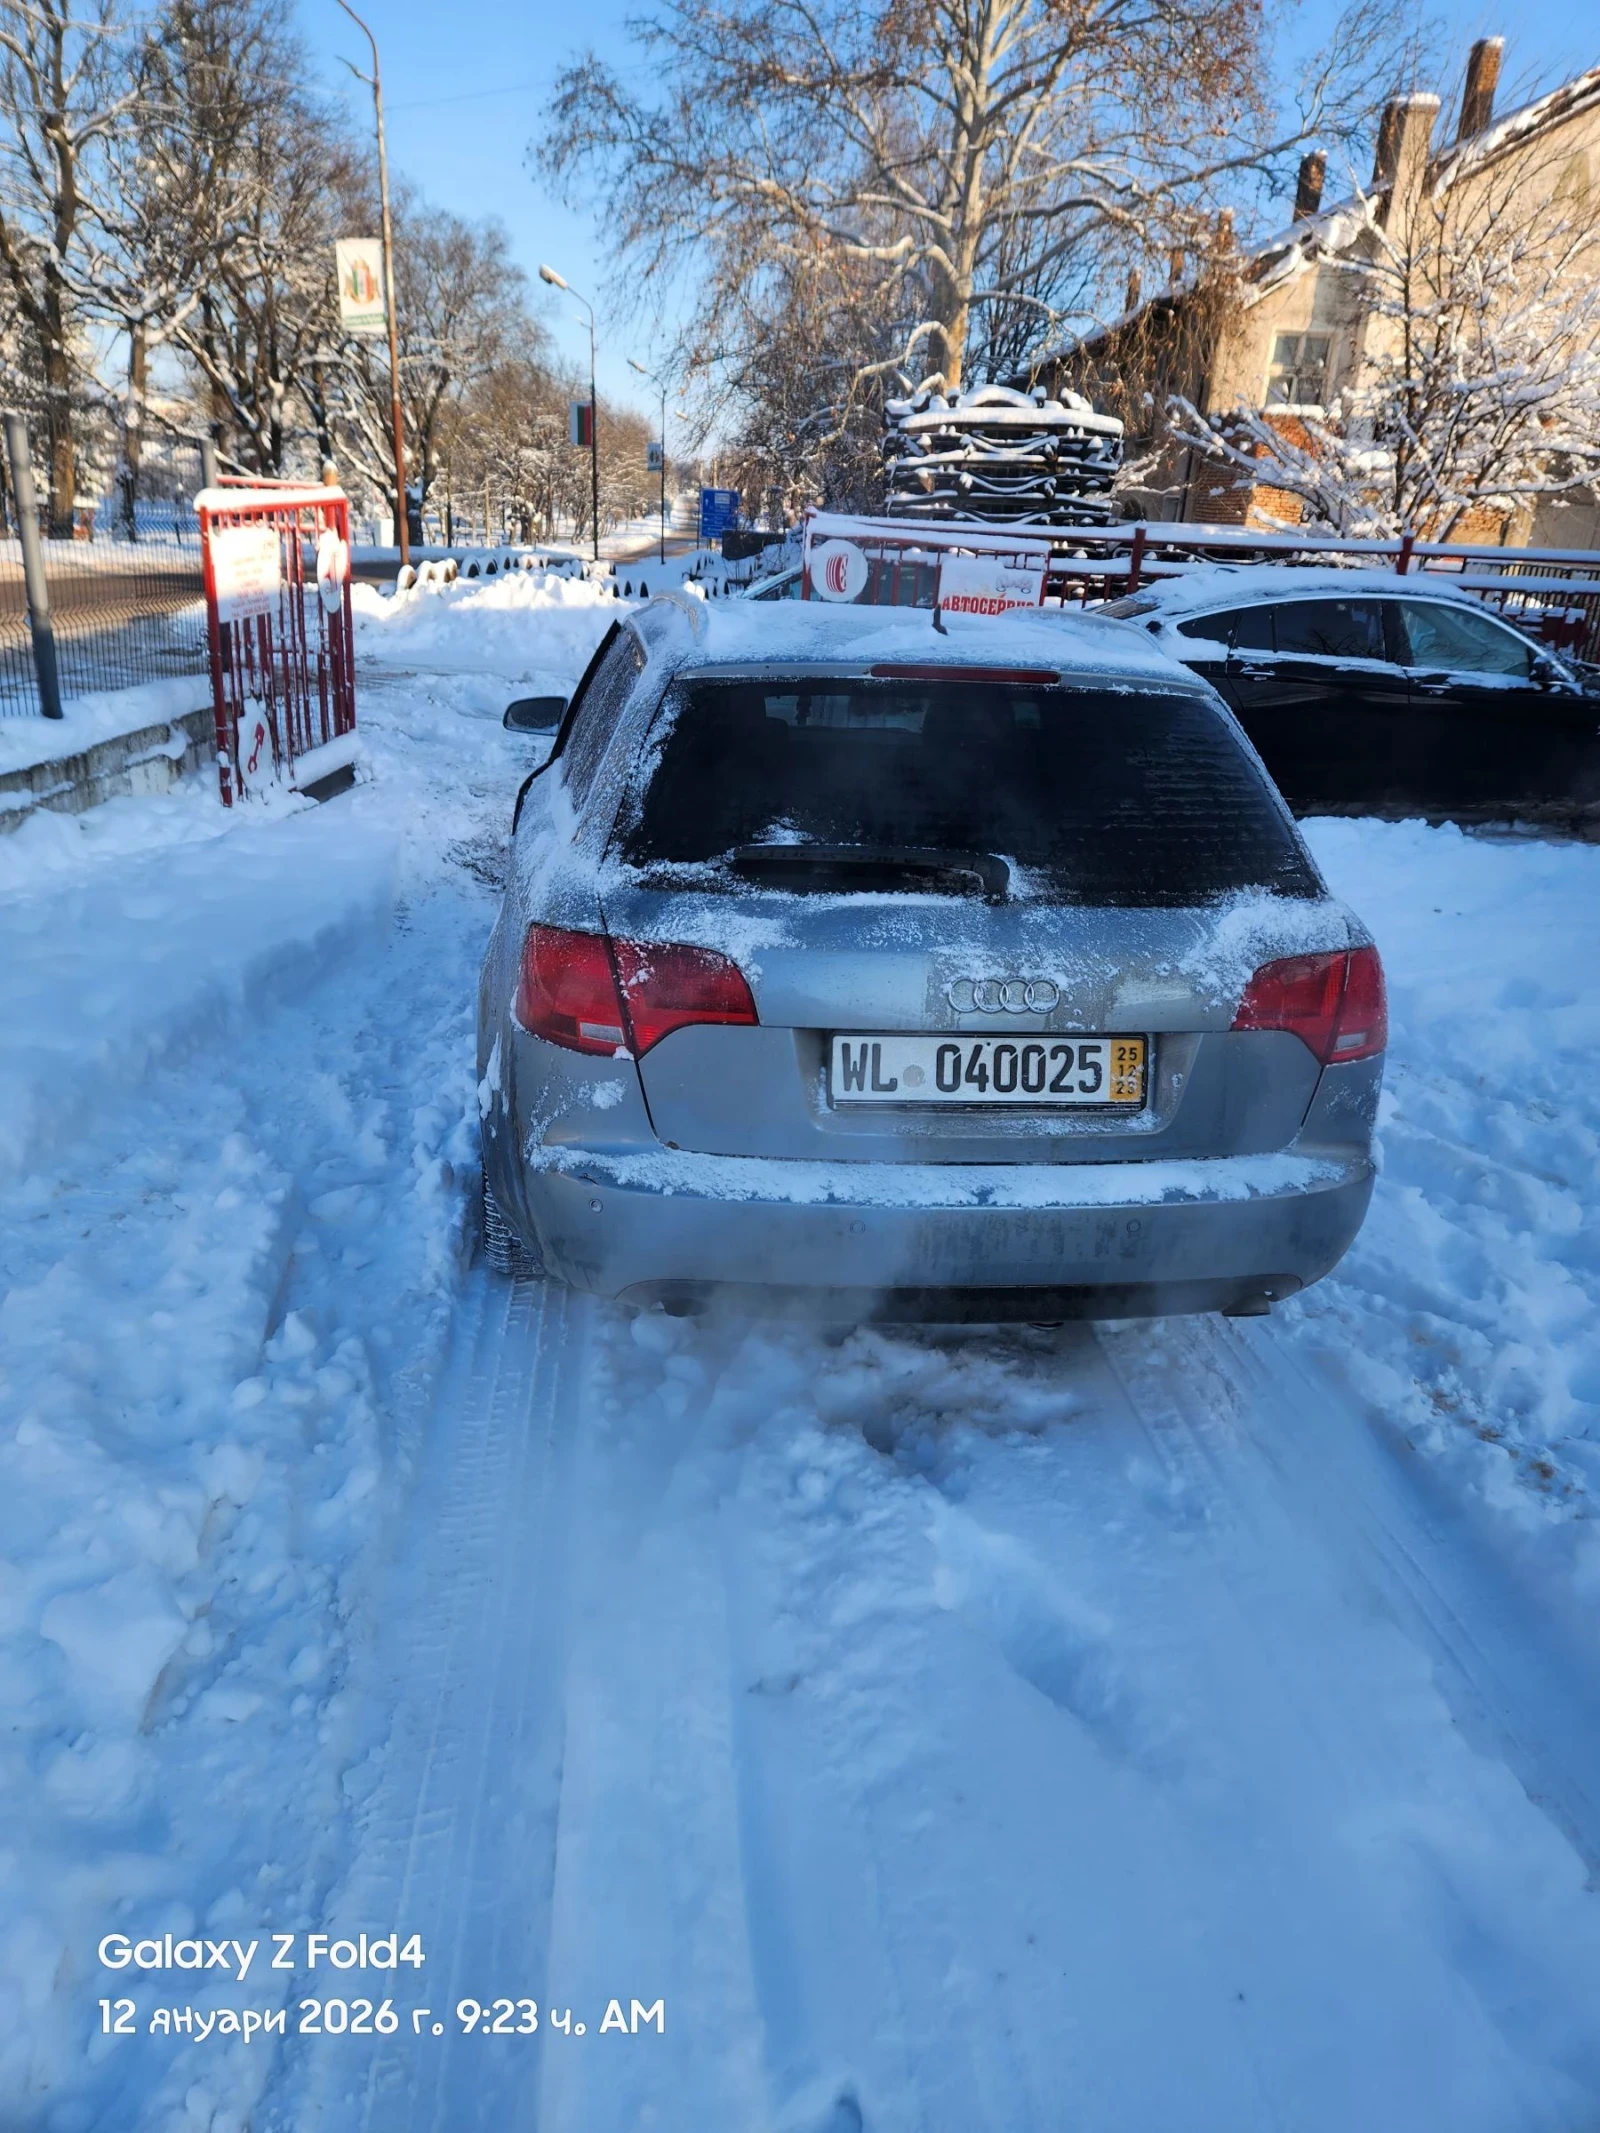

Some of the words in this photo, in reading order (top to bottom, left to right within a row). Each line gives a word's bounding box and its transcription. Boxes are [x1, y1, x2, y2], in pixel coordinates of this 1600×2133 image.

[1117, 1046, 1138, 1061] 25
[841, 1043, 898, 1092] WL
[936, 1043, 1103, 1093] 040025
[1118, 1064, 1137, 1078] 12
